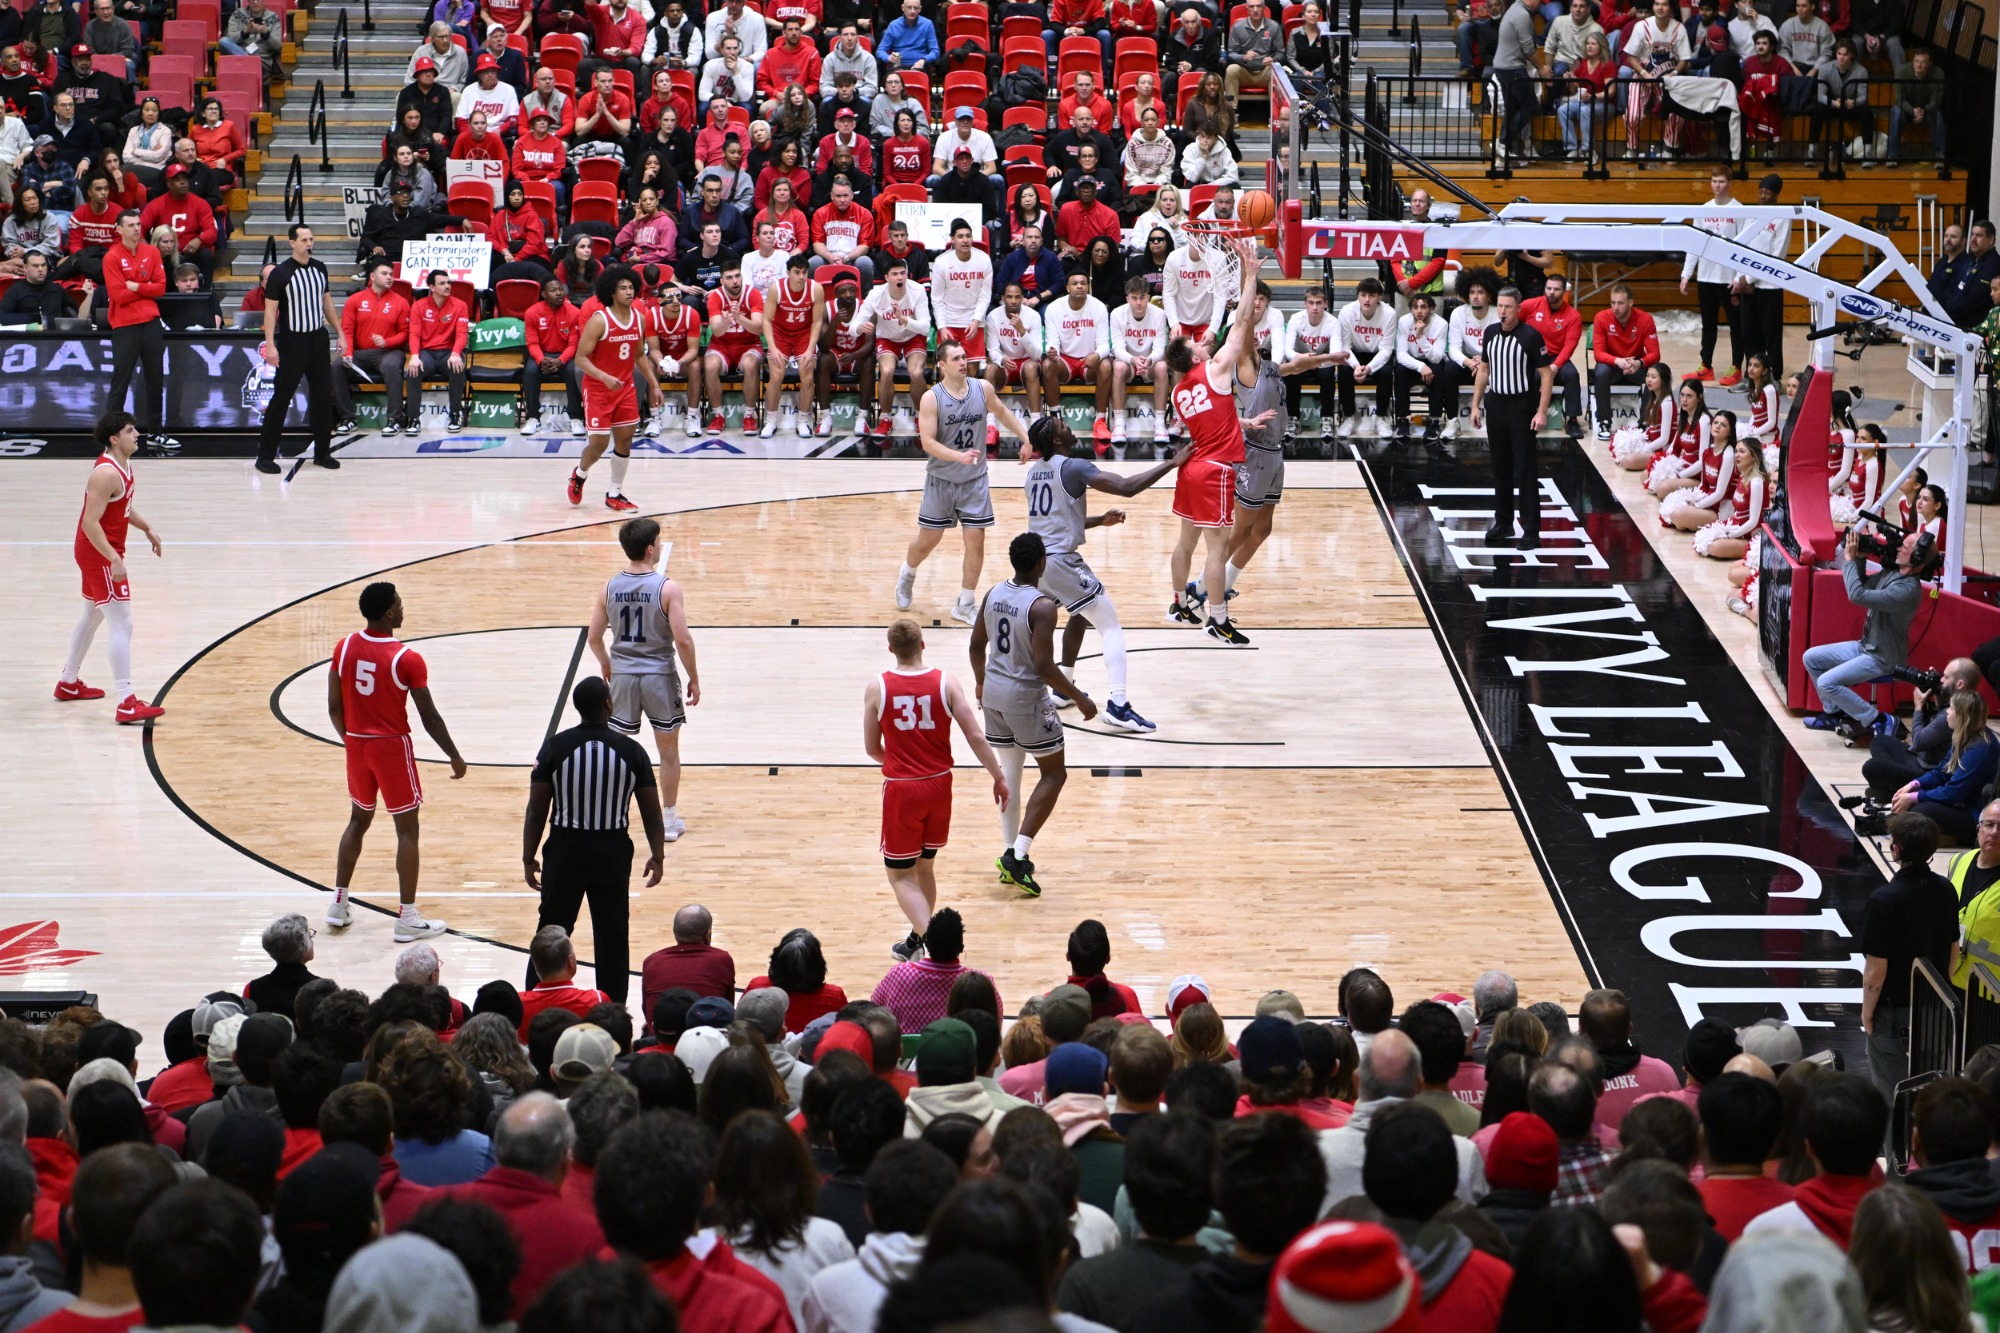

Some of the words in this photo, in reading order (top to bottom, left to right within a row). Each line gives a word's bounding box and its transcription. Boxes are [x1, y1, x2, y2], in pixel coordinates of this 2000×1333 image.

[893, 154, 920, 169] 24
[344, 187, 384, 205] BLIN
[897, 204, 926, 216] TURN
[171, 212, 187, 233] C
[824, 226, 856, 238] CORNELL
[409, 241, 487, 257] Exterminators
[1340, 232, 1411, 258] TIAA
[406, 256, 443, 269] CAN'T
[446, 256, 479, 270] STOP
[1730, 253, 1796, 281] LEGACY
[949, 271, 968, 281] LOCK
[969, 271, 975, 280] IT
[1180, 270, 1197, 279] LOCK
[965, 281, 971, 289] C
[786, 311, 806, 323] 14
[882, 311, 897, 321] LOC
[1062, 320, 1080, 329] LOCK
[1080, 319, 1086, 328] IT
[1884, 311, 1953, 342] SPORTS
[475, 327, 505, 345] Ivy
[608, 333, 639, 343] CORNELL
[1000, 328, 1015, 337] LOCK
[1125, 329, 1142, 337] LOCK
[1142, 329, 1148, 337] IT
[1465, 327, 1483, 337] LOCK
[618, 343, 630, 360] 8
[1176, 383, 1214, 419] 22
[355, 403, 381, 419] Ivy
[428, 404, 450, 415] TIA
[473, 401, 500, 418] Ivy
[549, 404, 567, 415] TIA
[667, 404, 688, 415] TIA
[780, 404, 799, 415] TIA
[829, 402, 855, 419] Ivy
[1010, 408, 1031, 419] TIA
[1059, 404, 1085, 422] Ivy
[1126, 407, 1156, 419] TIAA
[1358, 407, 1377, 418] TIA
[944, 412, 983, 426] Bulldogs
[526, 438, 747, 454] TAA
[953, 428, 974, 449] 42
[1031, 471, 1055, 481] ALETAN
[1029, 482, 1053, 517] 10
[1417, 477, 1610, 571] THE
[615, 592, 651, 603] MULLIN
[619, 605, 647, 642] 11
[996, 617, 1011, 655] 8
[1469, 583, 1687, 686] IVY
[355, 659, 377, 696] 5
[892, 694, 936, 731] 31
[1526, 701, 1868, 1034] LEAGUE
[1452, 1089, 1485, 1105] ADLE
